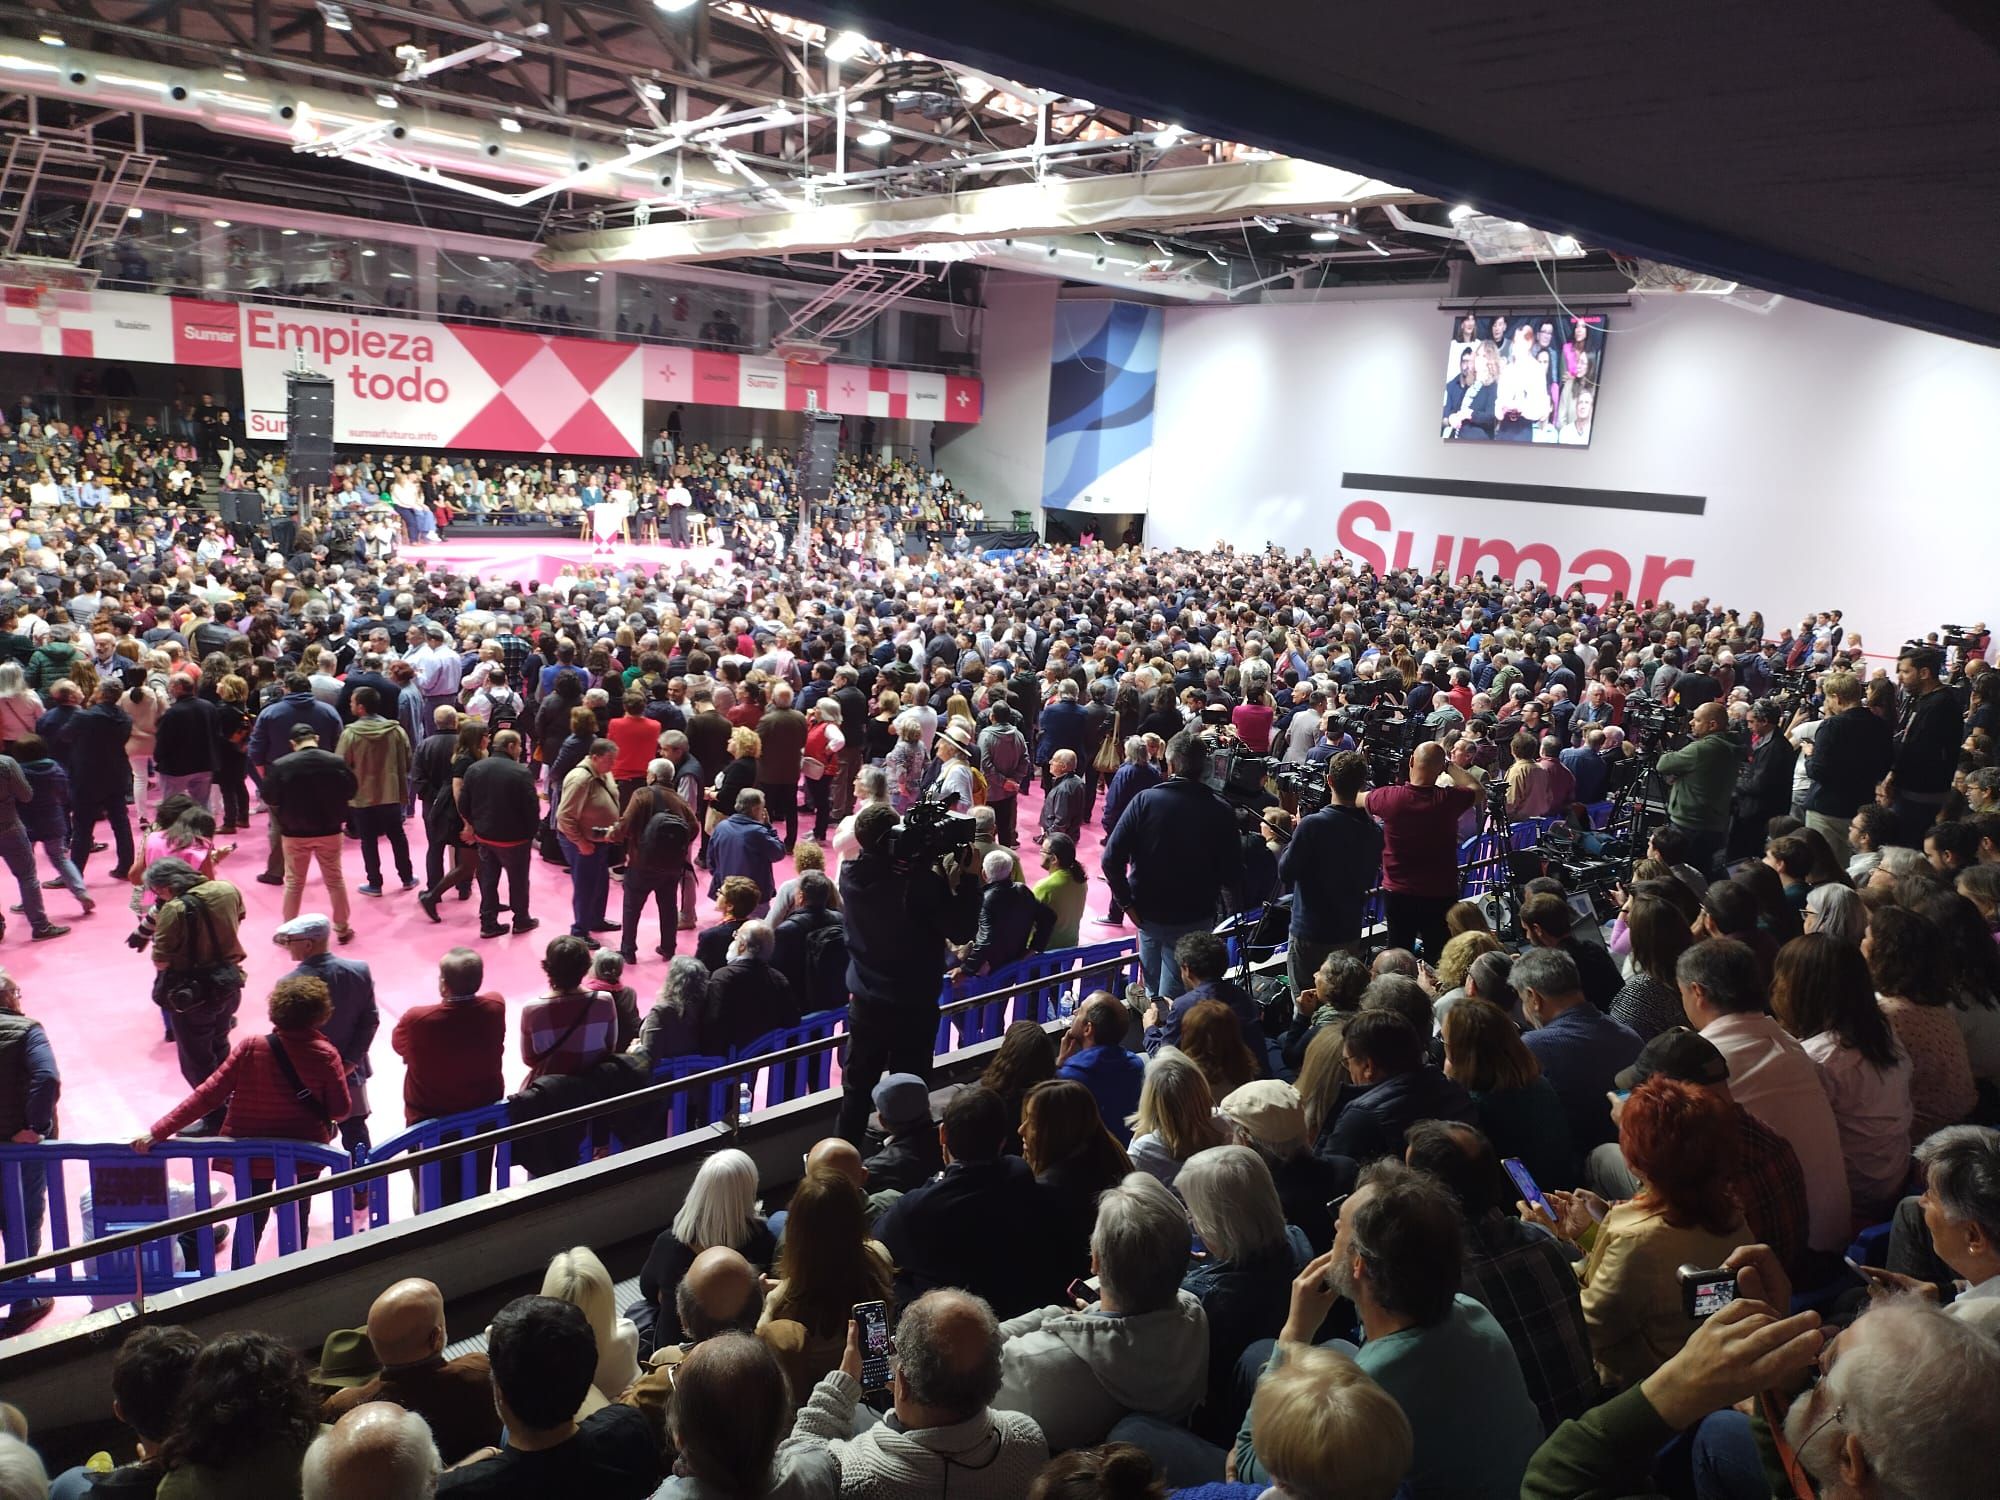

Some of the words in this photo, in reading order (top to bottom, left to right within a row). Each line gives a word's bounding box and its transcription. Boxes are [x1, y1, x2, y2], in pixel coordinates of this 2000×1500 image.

[184, 325, 237, 343] Sumar
[248, 310, 434, 364] Empieza
[348, 364, 449, 404] todo
[746, 377, 778, 389] Sumar
[348, 428, 439, 441] sumarfuturo.info
[1337, 500, 1695, 613] Sumar
